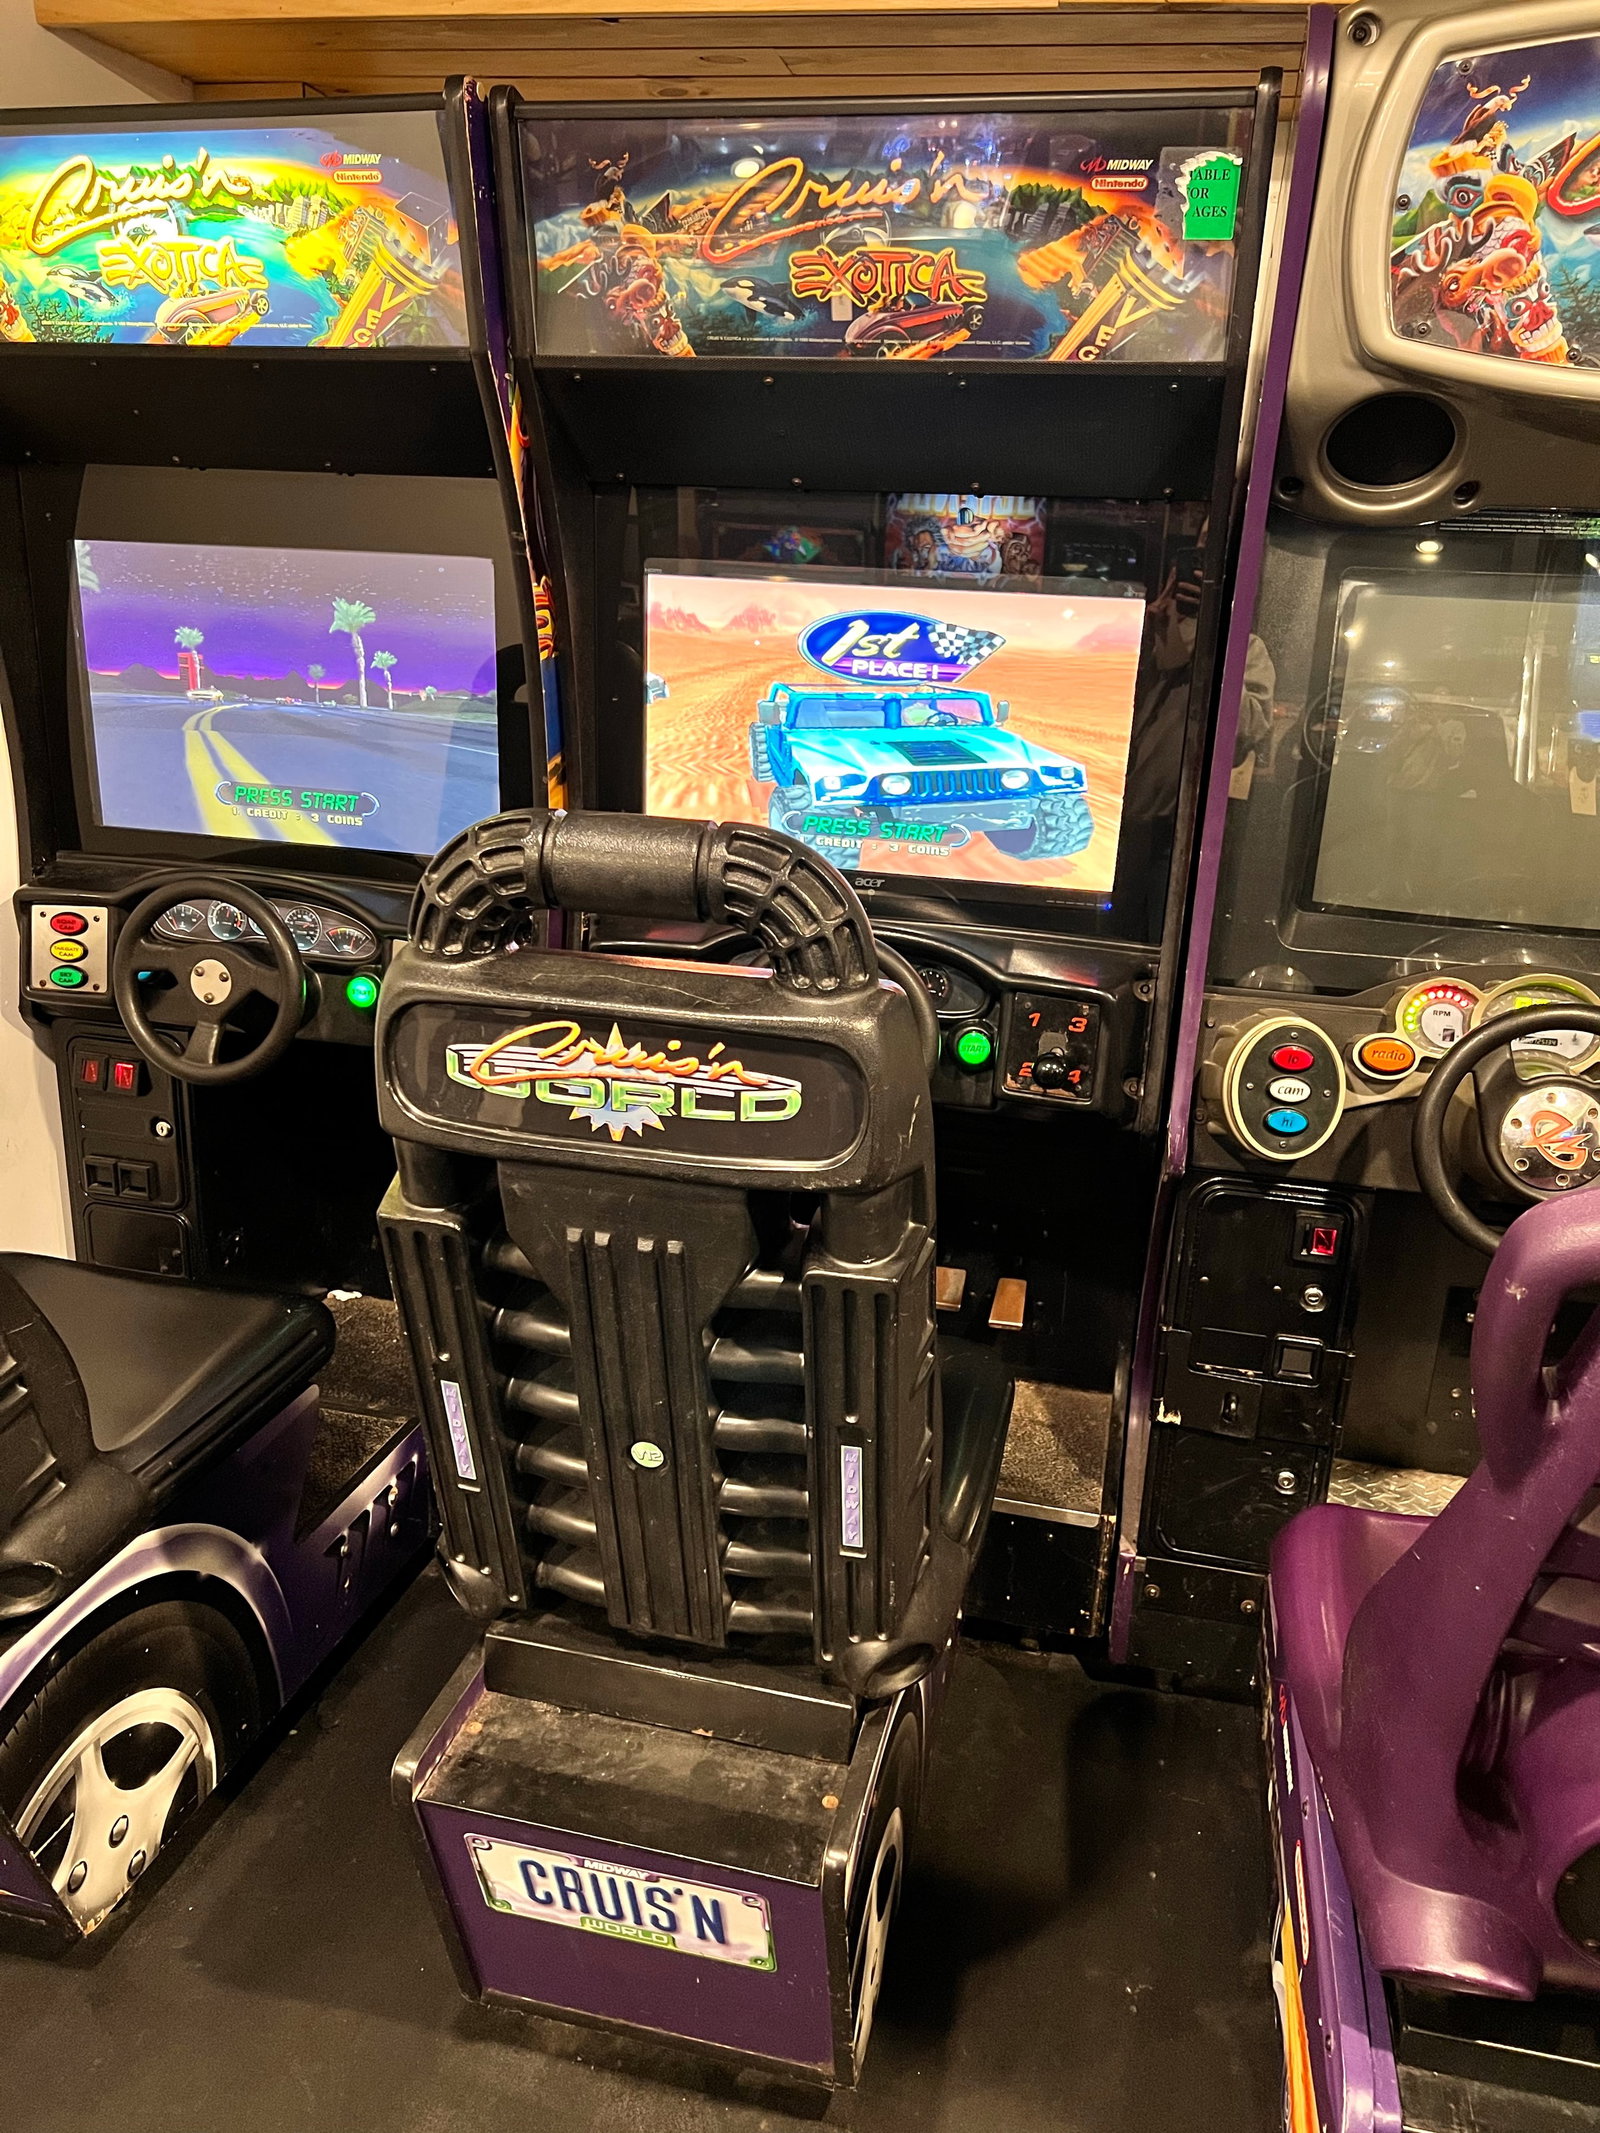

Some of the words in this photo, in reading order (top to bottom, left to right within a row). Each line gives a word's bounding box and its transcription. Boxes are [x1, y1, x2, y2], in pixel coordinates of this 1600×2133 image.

[342, 153, 382, 165] MIDWAY
[1106, 158, 1154, 171] MIDWAY
[336, 171, 380, 182] Nintendo
[1093, 177, 1146, 189] Nintendo
[25, 148, 252, 255] Cruis'n
[702, 151, 991, 263] Cruis'n
[1192, 205, 1228, 218] AGES
[97, 236, 270, 294] EXOTICA
[790, 246, 988, 306] EXOTICA
[348, 279, 414, 347] VEG
[821, 619, 920, 667] 1st
[851, 659, 939, 679] PLACE!
[234, 786, 293, 806] PRESS
[301, 791, 359, 812] START
[247, 808, 288, 820] CREDIT
[311, 813, 319, 823] 3
[327, 815, 363, 826] COINS
[802, 816, 871, 838] PRESS
[880, 822, 948, 843] START
[816, 837, 863, 849] CREDIT
[889, 843, 899, 852] 3
[908, 845, 950, 856] COINS
[855, 877, 885, 887] acer
[1028, 1012, 1041, 1027] 1
[1068, 1017, 1088, 1033] 3
[1432, 1009, 1451, 1017] RPM
[471, 1021, 773, 1085] Cruis'n
[961, 1044, 987, 1053] START
[1371, 1049, 1406, 1062] radio
[1018, 1062, 1034, 1078] 2
[1277, 1085, 1304, 1096] cam
[1281, 1117, 1294, 1128] hi
[446, 1387, 471, 1474] MIDWAY
[632, 1450, 663, 1462] V12
[845, 1453, 860, 1541] MIDWAY
[584, 1860, 651, 1880] MIDWAY
[518, 1859, 726, 1945] CRUIS'N
[584, 1918, 669, 1945] WORLD
